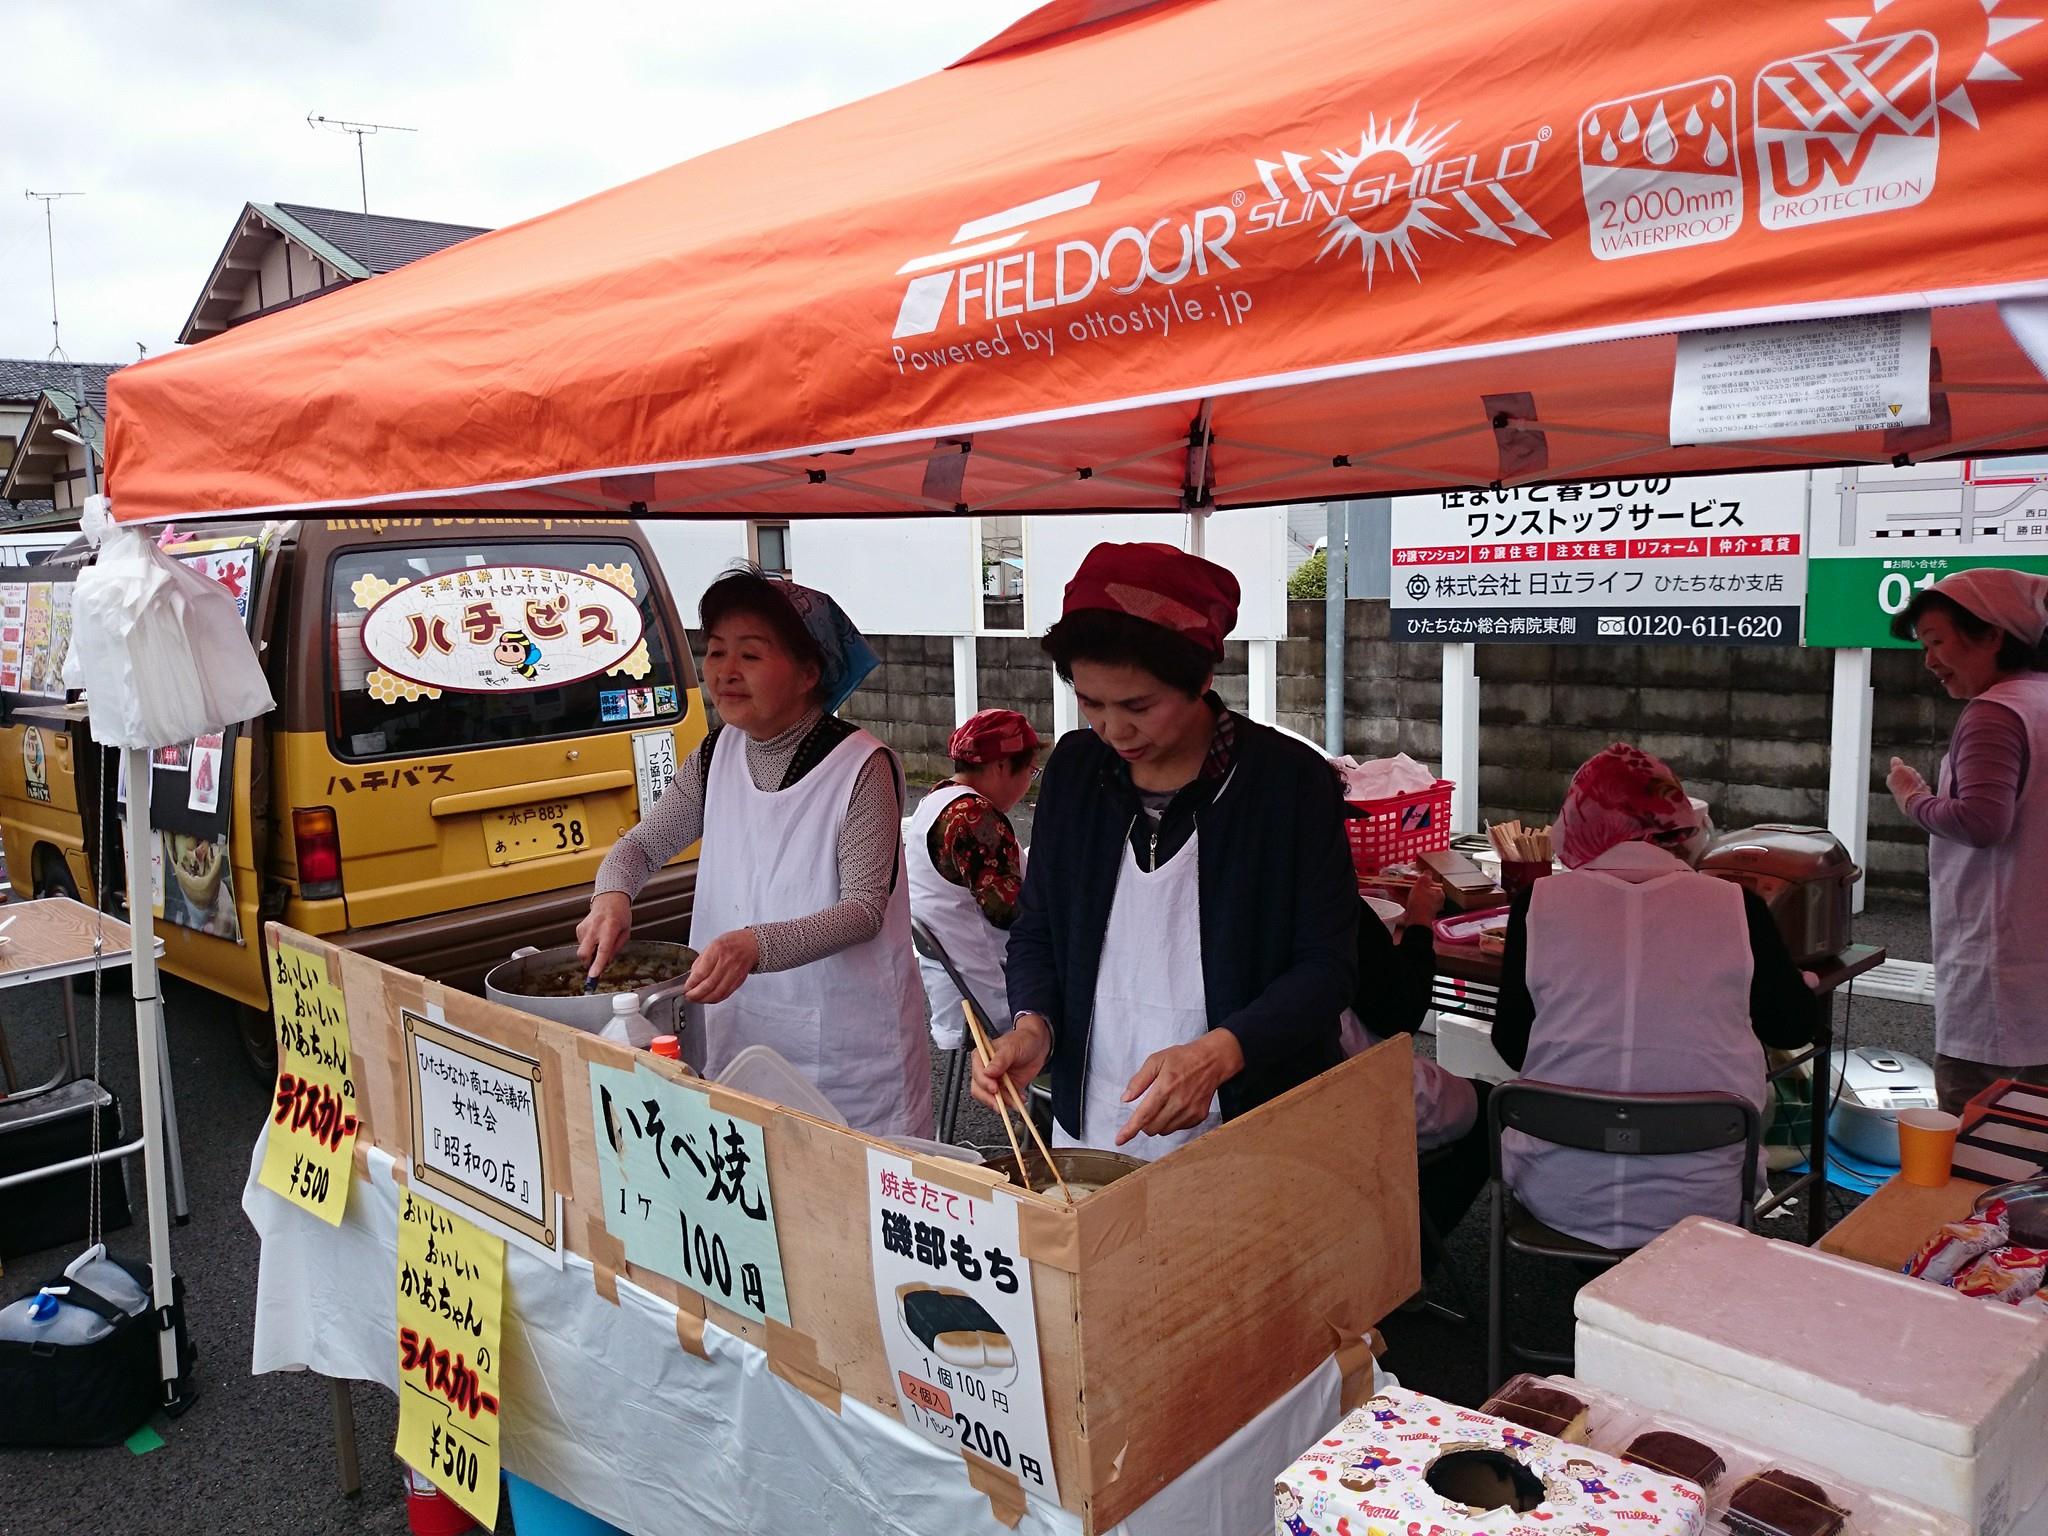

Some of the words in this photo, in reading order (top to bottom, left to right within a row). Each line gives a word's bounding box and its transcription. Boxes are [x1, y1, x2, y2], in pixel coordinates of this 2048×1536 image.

[1245, 184, 1345, 234] SUN
[1349, 139, 1540, 212] SHIELD
[1768, 133, 1877, 198] UV
[1600, 187, 1734, 232] 2,000mm
[1772, 177, 1922, 221] PROTECTION
[1601, 213, 1736, 253] WATERPROOF
[891, 323, 1011, 374] Powered
[1015, 320, 1054, 356] by
[1069, 285, 1253, 342] ottostyle.jp
[1467, 498, 1744, 538] ワンストップサービス
[2026, 508, 2047, 518] 西口
[1396, 549, 1466, 564] 分譲マンション
[1478, 546, 1538, 560] 分譲住宅
[1556, 543, 1618, 558] 注文住宅
[1637, 540, 1700, 555] リフォーム
[1435, 573, 1522, 599] 株式会社
[1529, 570, 1644, 597] 日立ライフ
[1655, 573, 1784, 593] ひたちなか支店
[1407, 616, 1577, 635] ひたちなか総合病院東側
[1628, 615, 1783, 637] 0120-611-620
[326, 763, 455, 796] ハチバス
[276, 951, 319, 990] おいしい
[295, 989, 340, 1028] おいしい
[419, 1052, 531, 1116] ひたちなか商工会議所
[274, 1072, 360, 1153] ライスカレー
[452, 1093, 498, 1134] 女性会
[433, 1127, 529, 1204] 『昭和の店』
[599, 1084, 768, 1222] いそべ焼
[403, 1194, 454, 1235] おいしい
[425, 1234, 480, 1281] おいしい
[881, 1207, 1020, 1294] 磯部もち
[400, 1327, 499, 1420] ライスカレー
[908, 1381, 946, 1412] 2個入
[954, 1411, 1045, 1486] 200円
